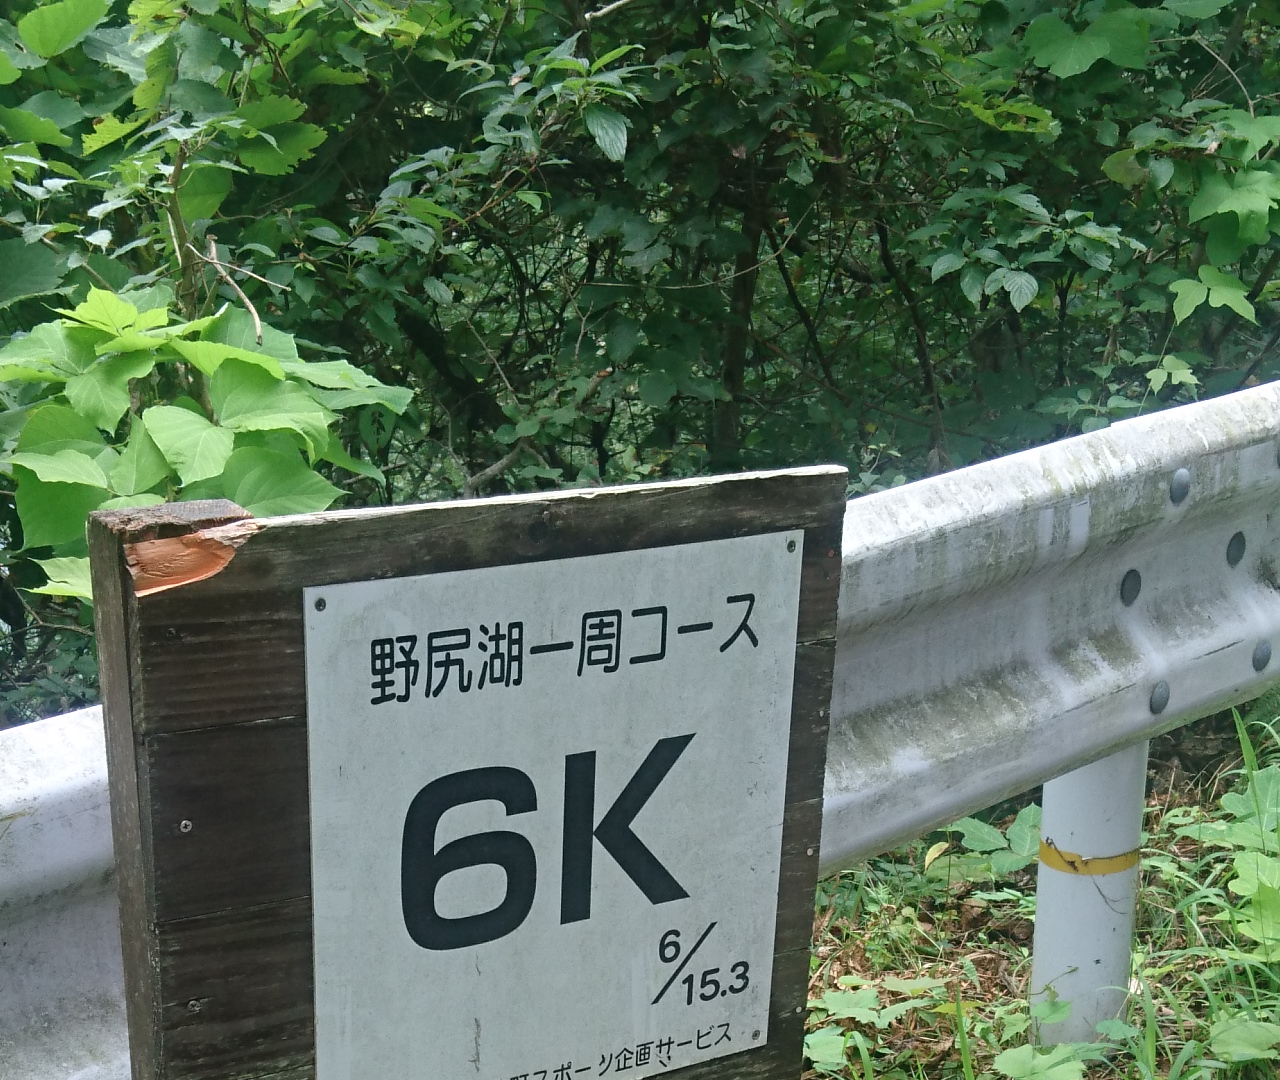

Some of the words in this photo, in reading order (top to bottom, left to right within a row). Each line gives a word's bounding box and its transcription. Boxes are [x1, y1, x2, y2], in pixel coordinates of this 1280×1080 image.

[371, 594, 759, 705] 野尻湖一周コース
[401, 733, 696, 950] 6K
